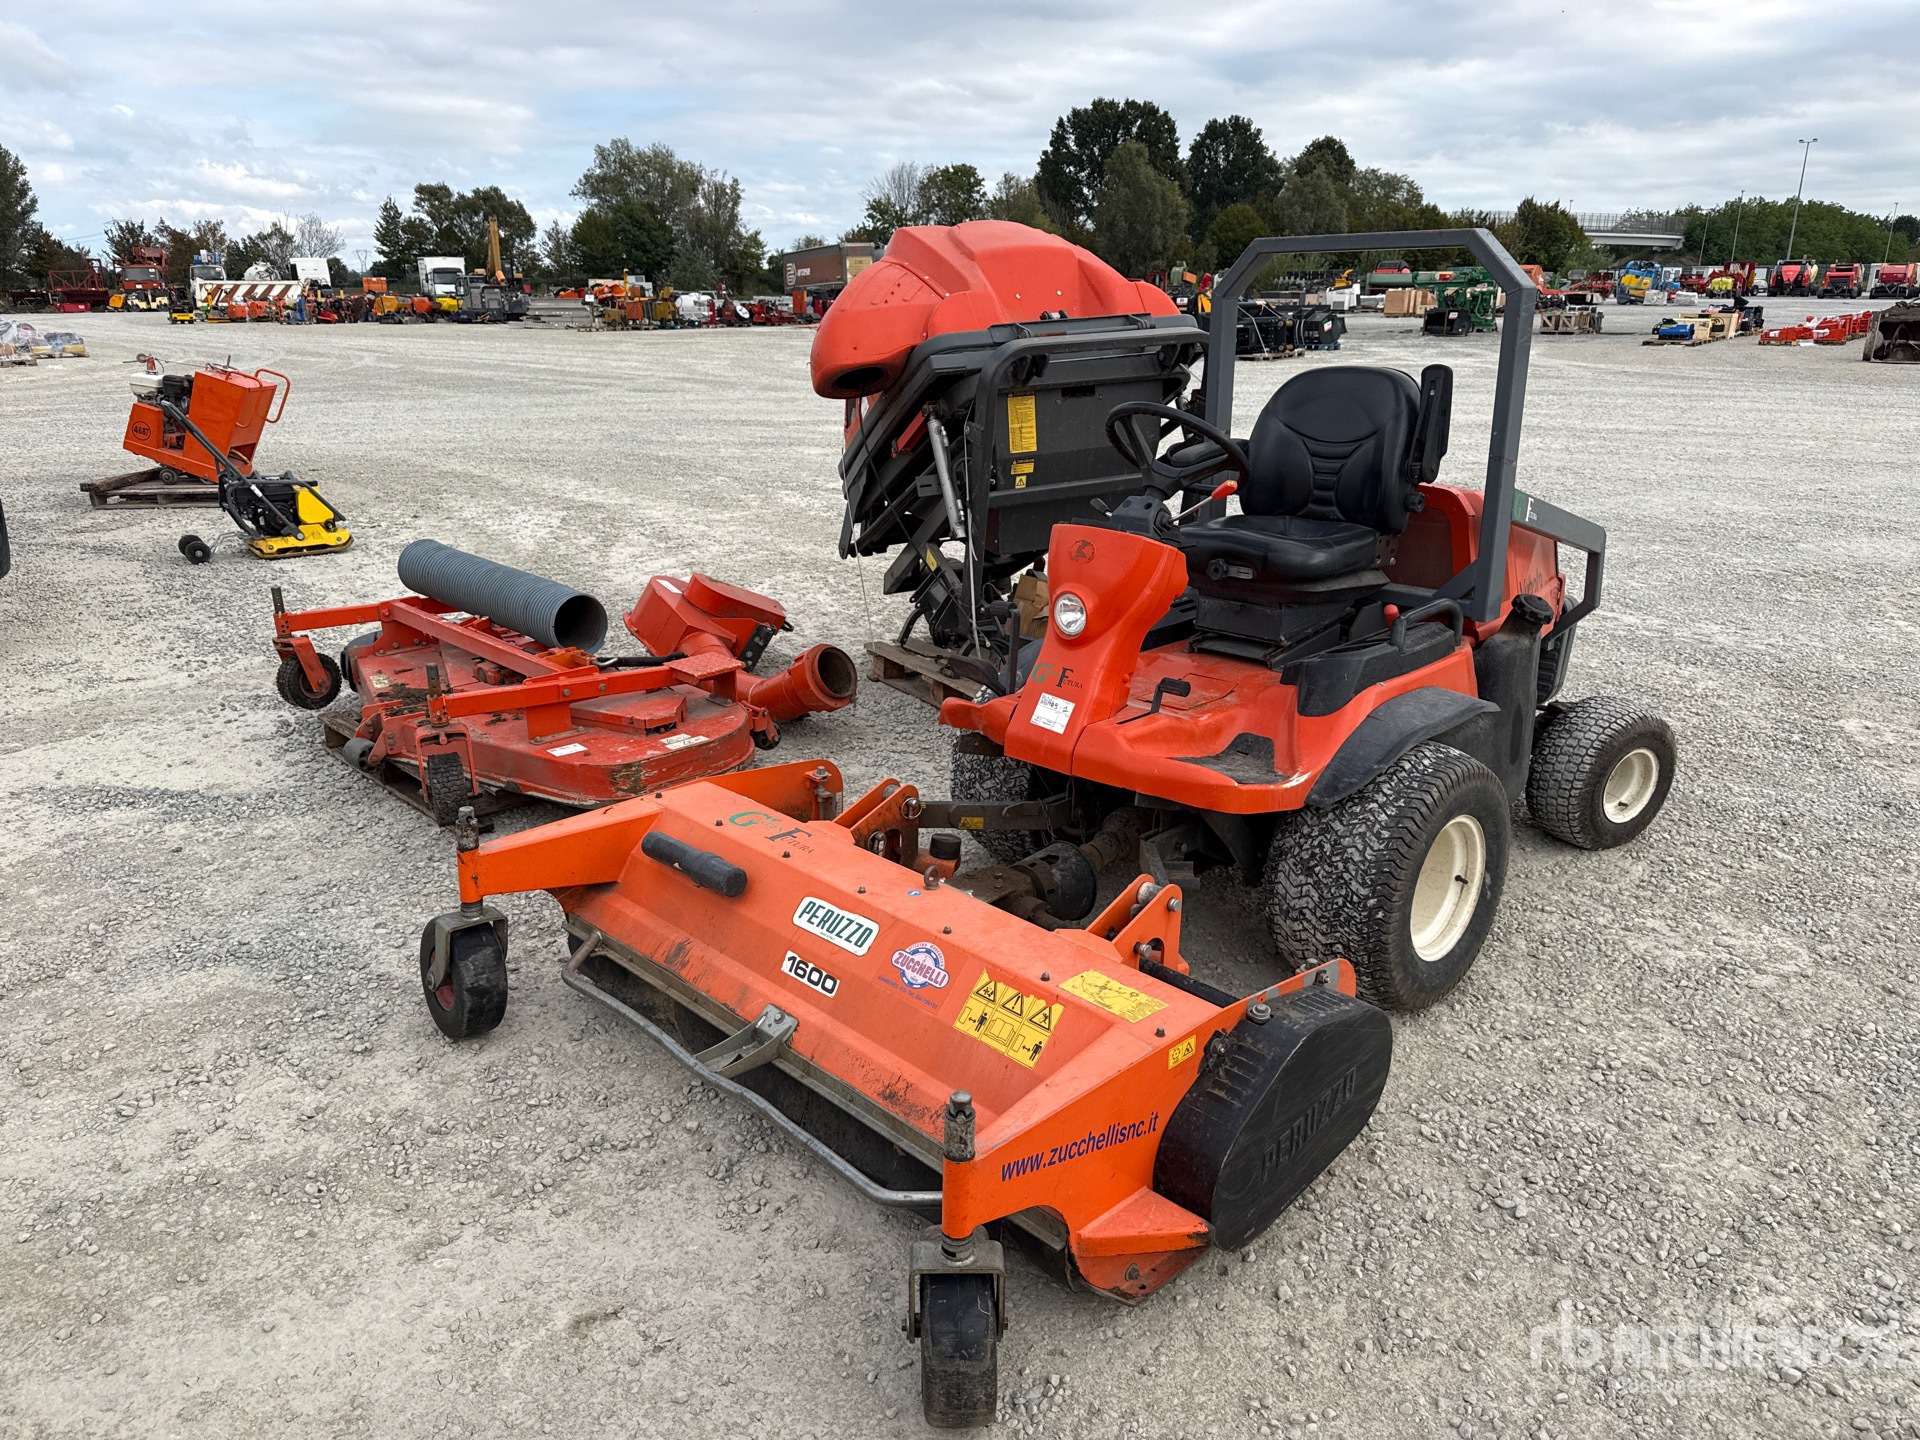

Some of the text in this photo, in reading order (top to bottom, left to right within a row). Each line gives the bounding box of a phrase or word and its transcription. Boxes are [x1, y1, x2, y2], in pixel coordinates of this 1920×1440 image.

[797, 900, 874, 949] PERUZZO
[787, 955, 838, 995] 1600
[893, 951, 947, 987] ZUCCHELLI
[1001, 1111, 1159, 1182] www.zucchellisnc.it
